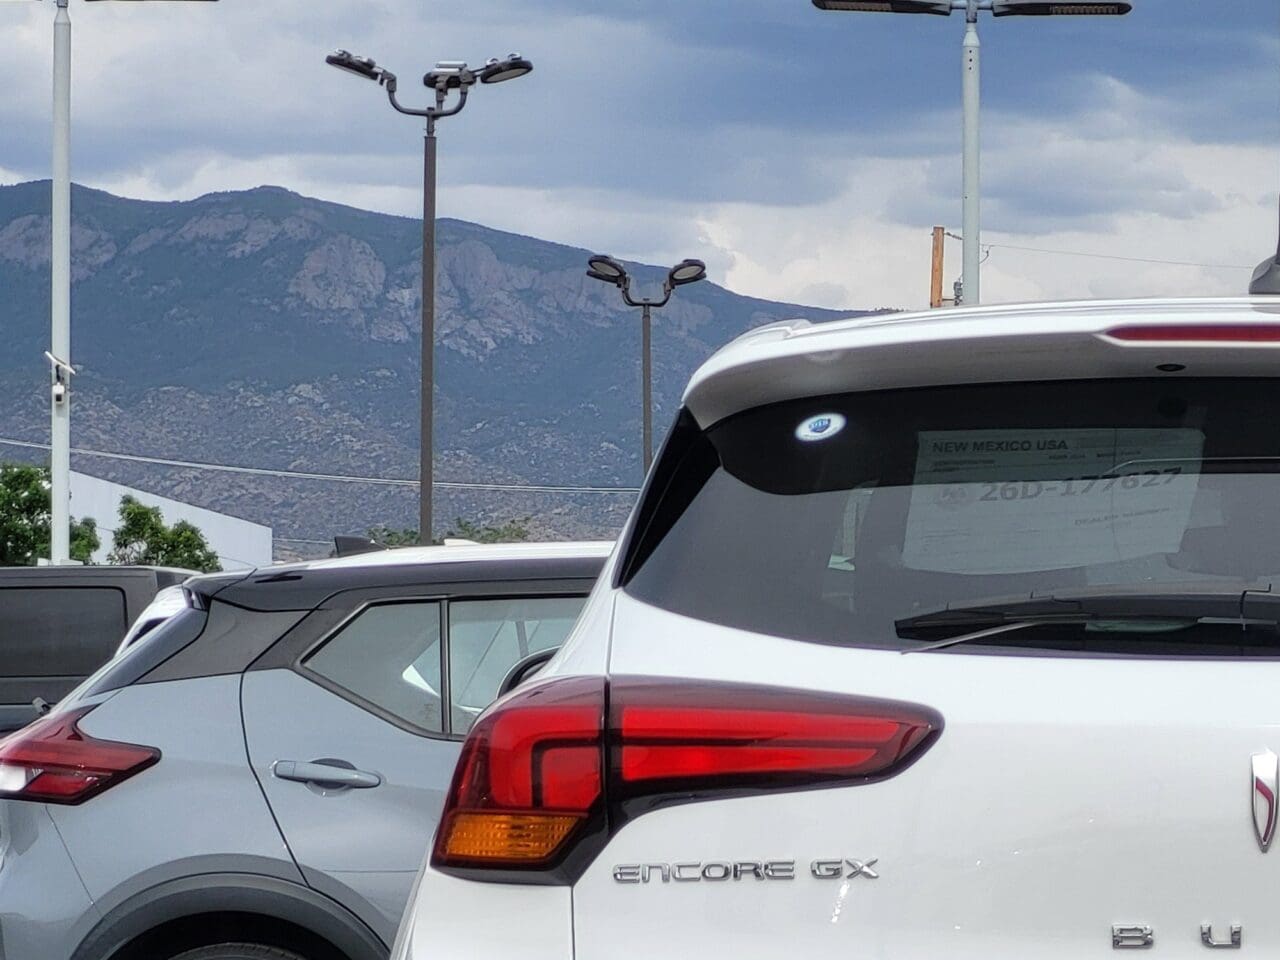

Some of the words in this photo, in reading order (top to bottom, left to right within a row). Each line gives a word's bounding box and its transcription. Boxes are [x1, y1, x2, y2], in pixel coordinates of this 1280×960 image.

[932, 442, 968, 453] NEW
[972, 440, 1032, 452] MEXICO
[1036, 440, 1068, 451] USA
[613, 859, 796, 884] ENCORE
[810, 857, 880, 882] GX
